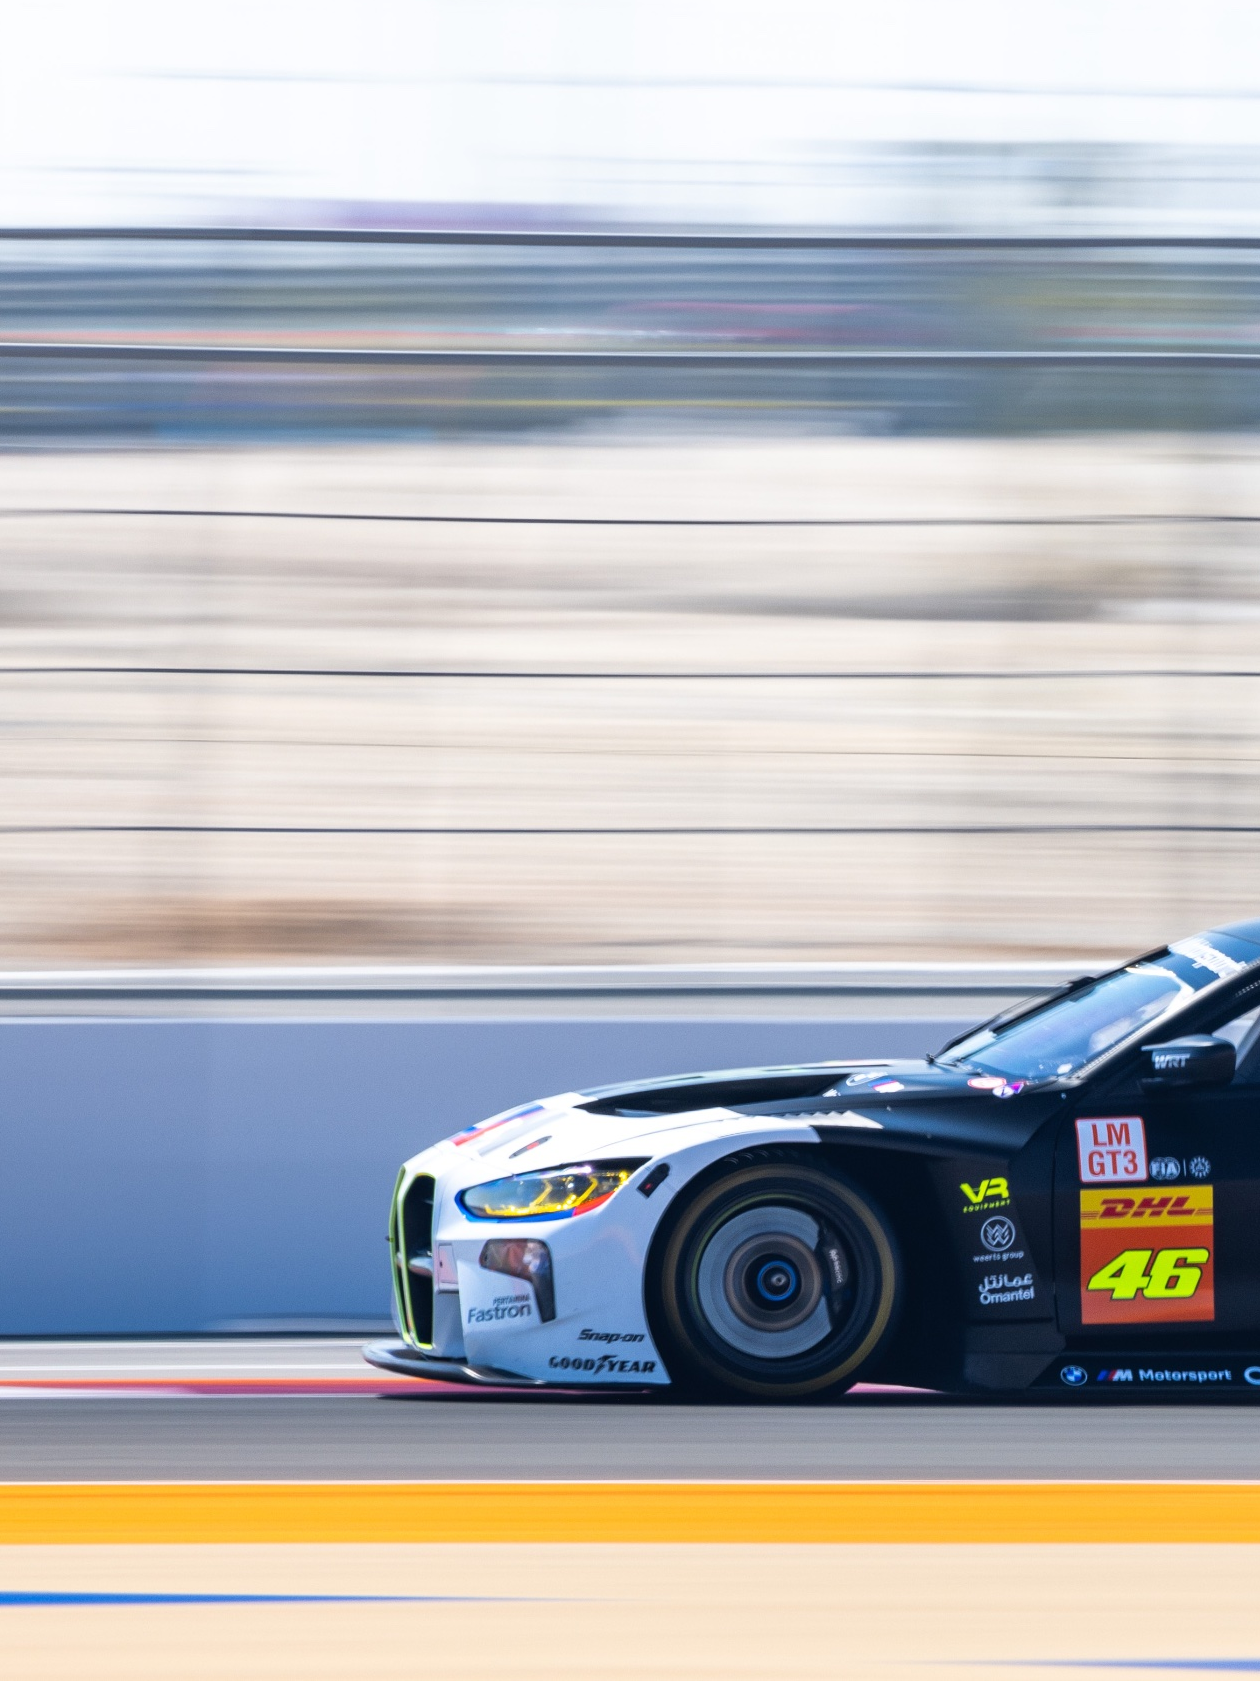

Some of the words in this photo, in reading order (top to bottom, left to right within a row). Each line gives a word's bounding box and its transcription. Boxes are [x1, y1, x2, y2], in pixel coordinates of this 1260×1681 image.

[1154, 1053, 1191, 1070] WRT
[1091, 1122, 1131, 1147] LM
[1088, 1150, 1138, 1177] GT3
[1150, 1160, 1178, 1177] FIA
[960, 1177, 1010, 1203] VR
[1099, 1196, 1196, 1219] DHL
[973, 1253, 1001, 1263] weerts
[1001, 1250, 1025, 1261] group
[1087, 1247, 1210, 1301] 46
[980, 1286, 1036, 1305] Omantel
[467, 1302, 531, 1324] Fastron
[578, 1328, 645, 1344] Snap-on
[548, 1354, 656, 1375] GOODYEAR
[1139, 1368, 1232, 1383] Motorsport
